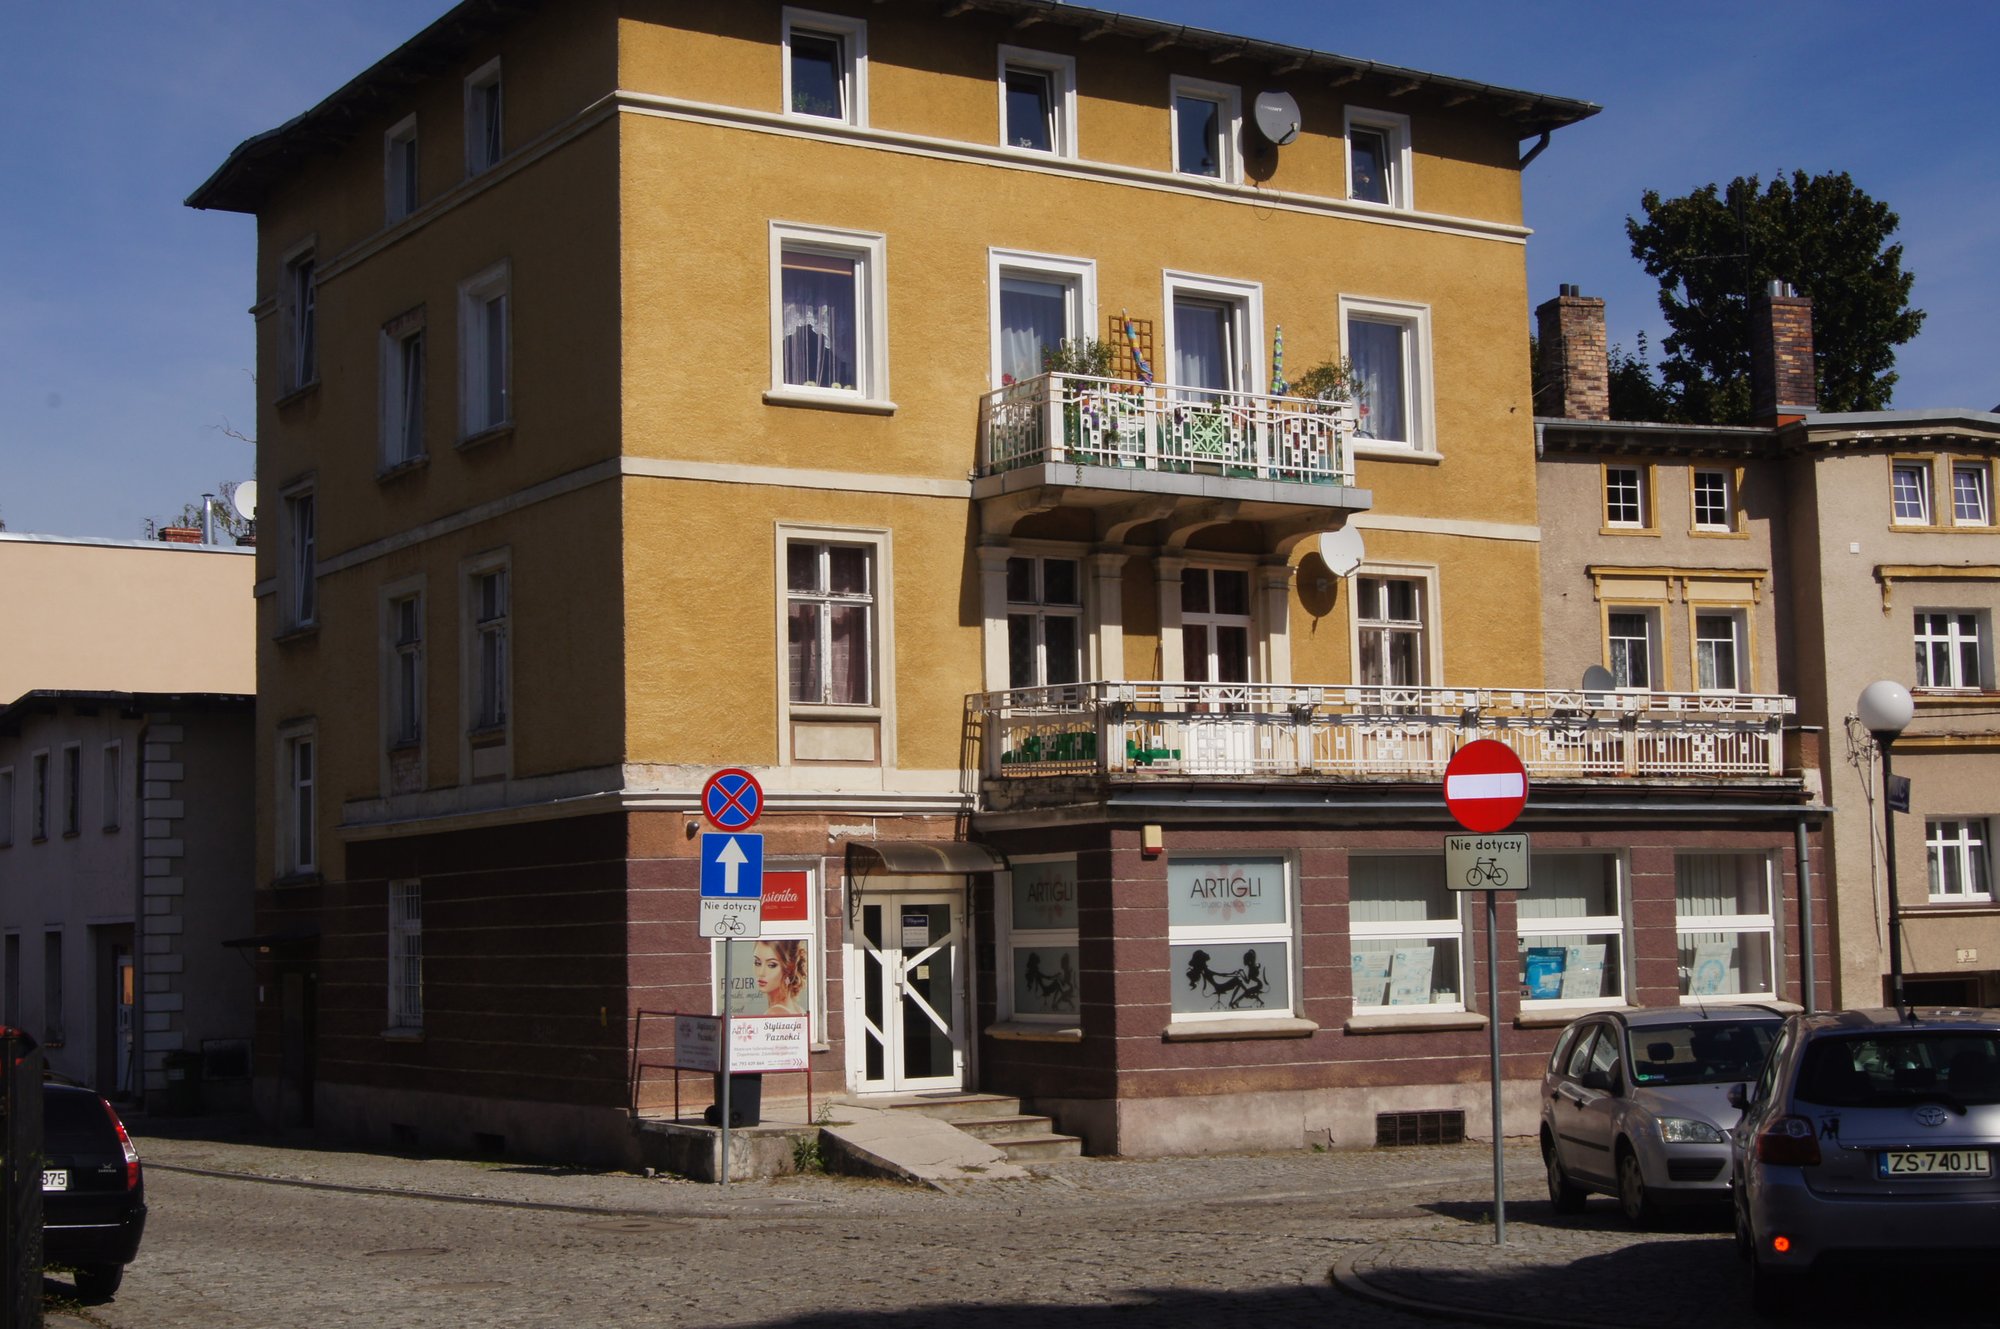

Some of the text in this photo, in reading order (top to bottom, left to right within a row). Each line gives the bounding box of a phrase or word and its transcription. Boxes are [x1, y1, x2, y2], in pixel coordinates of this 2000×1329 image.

[1450, 838, 1522, 853] Nie dotyczy
[1027, 881, 1073, 903] ARTIGLI
[1190, 877, 1262, 899] ARTIGLI
[704, 901, 720, 910] Nie
[723, 901, 757, 912] dotyczy
[720, 977, 755, 990] FYZJER
[764, 1022, 801, 1031] Stylizacja
[765, 1033, 801, 1041] Paznokci
[1891, 1154, 1920, 1172] ZS
